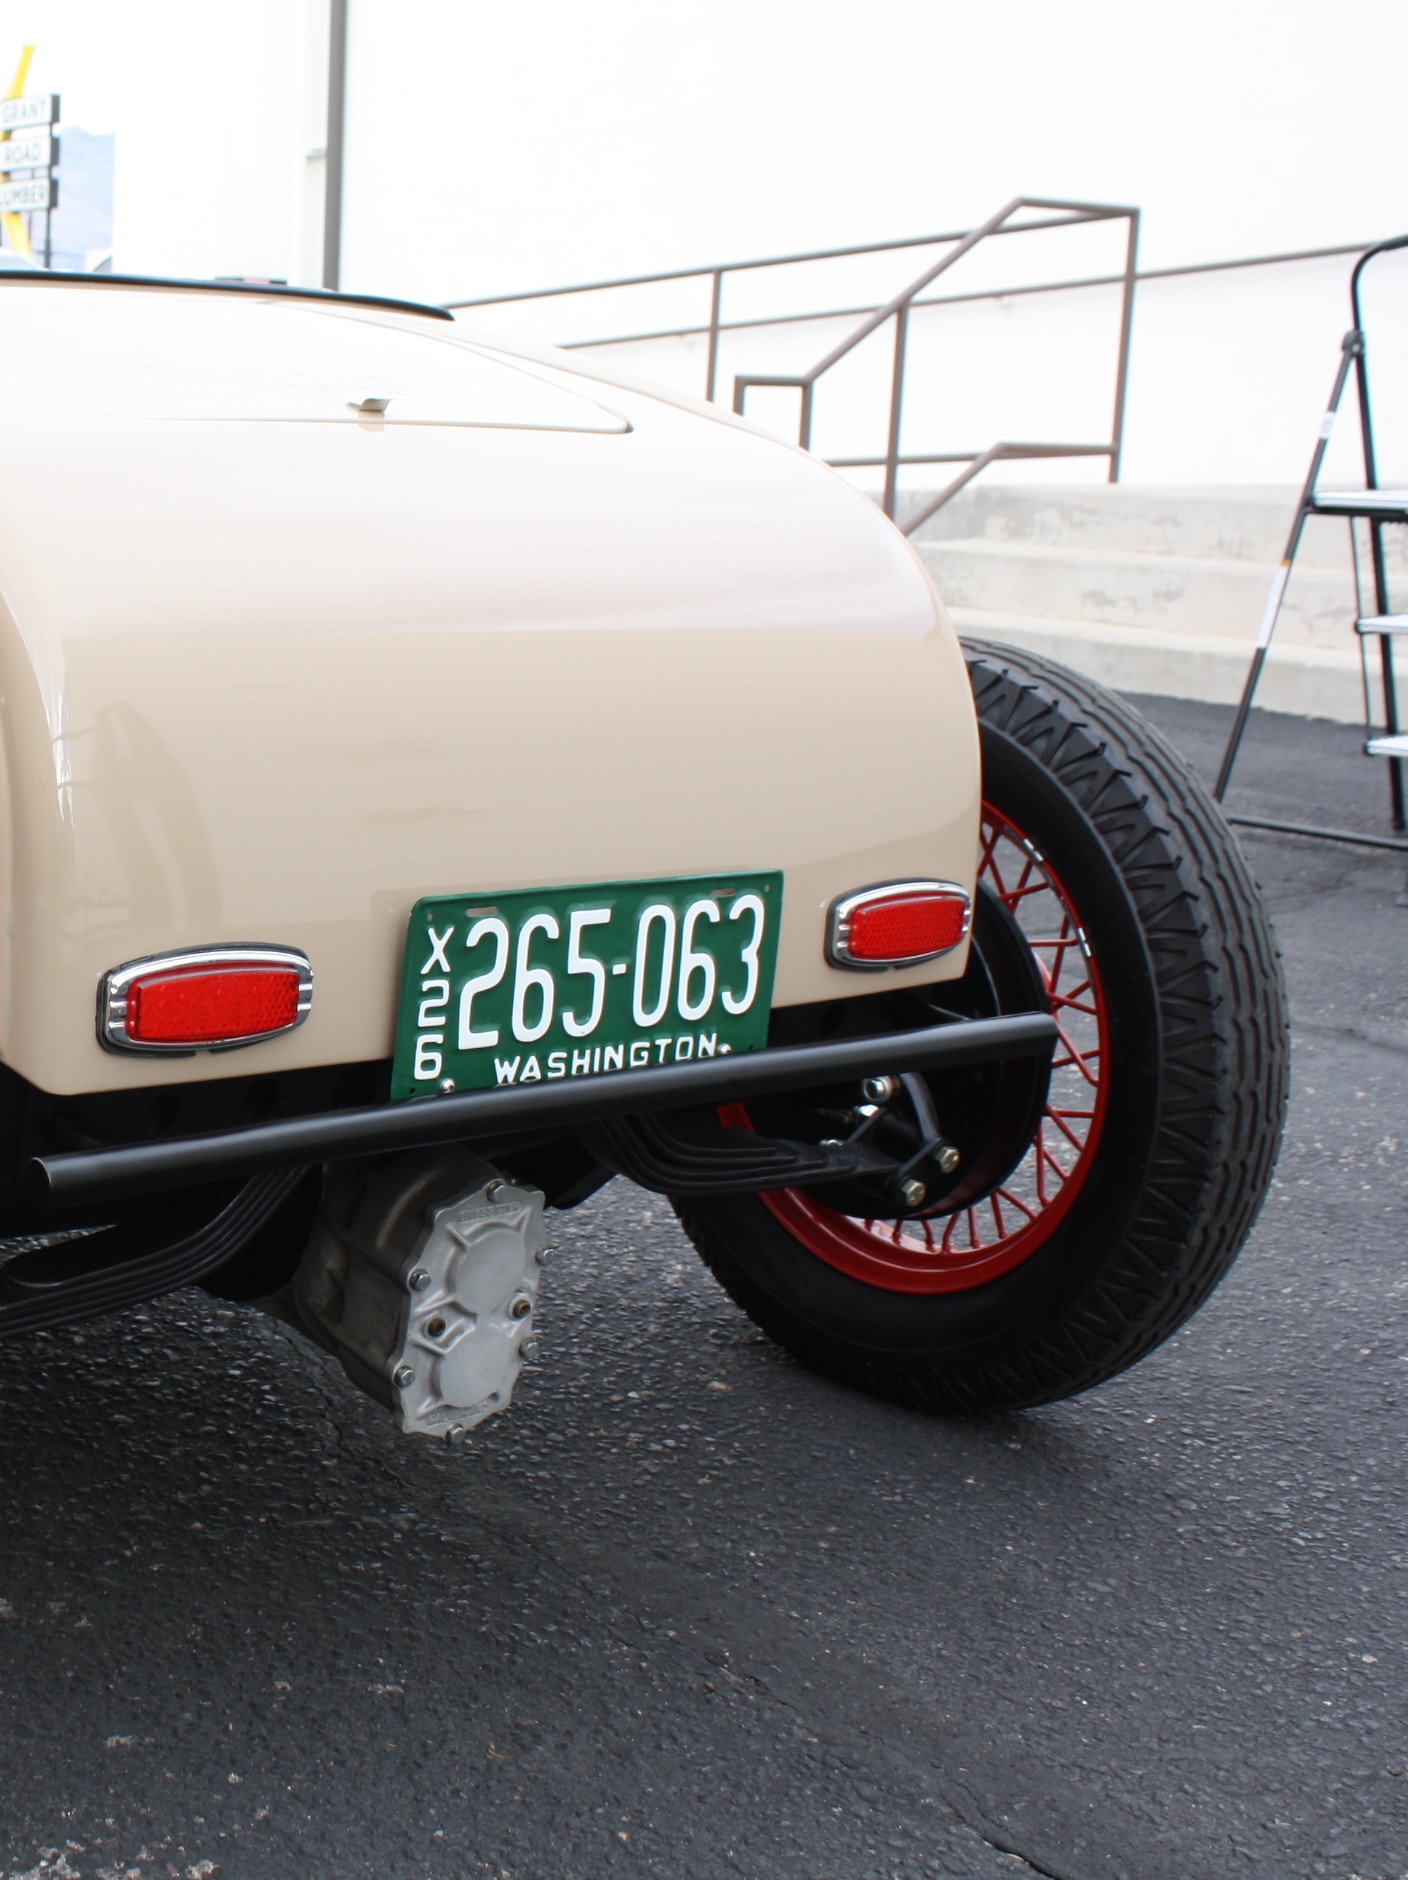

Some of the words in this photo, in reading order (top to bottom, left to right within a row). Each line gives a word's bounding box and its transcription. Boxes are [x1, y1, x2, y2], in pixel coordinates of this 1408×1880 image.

[1, 98, 46, 124] GRANT
[4, 142, 41, 164] ROAD
[458, 894, 765, 1050] 265-063
[494, 1033, 718, 1085] WASHINGTON
